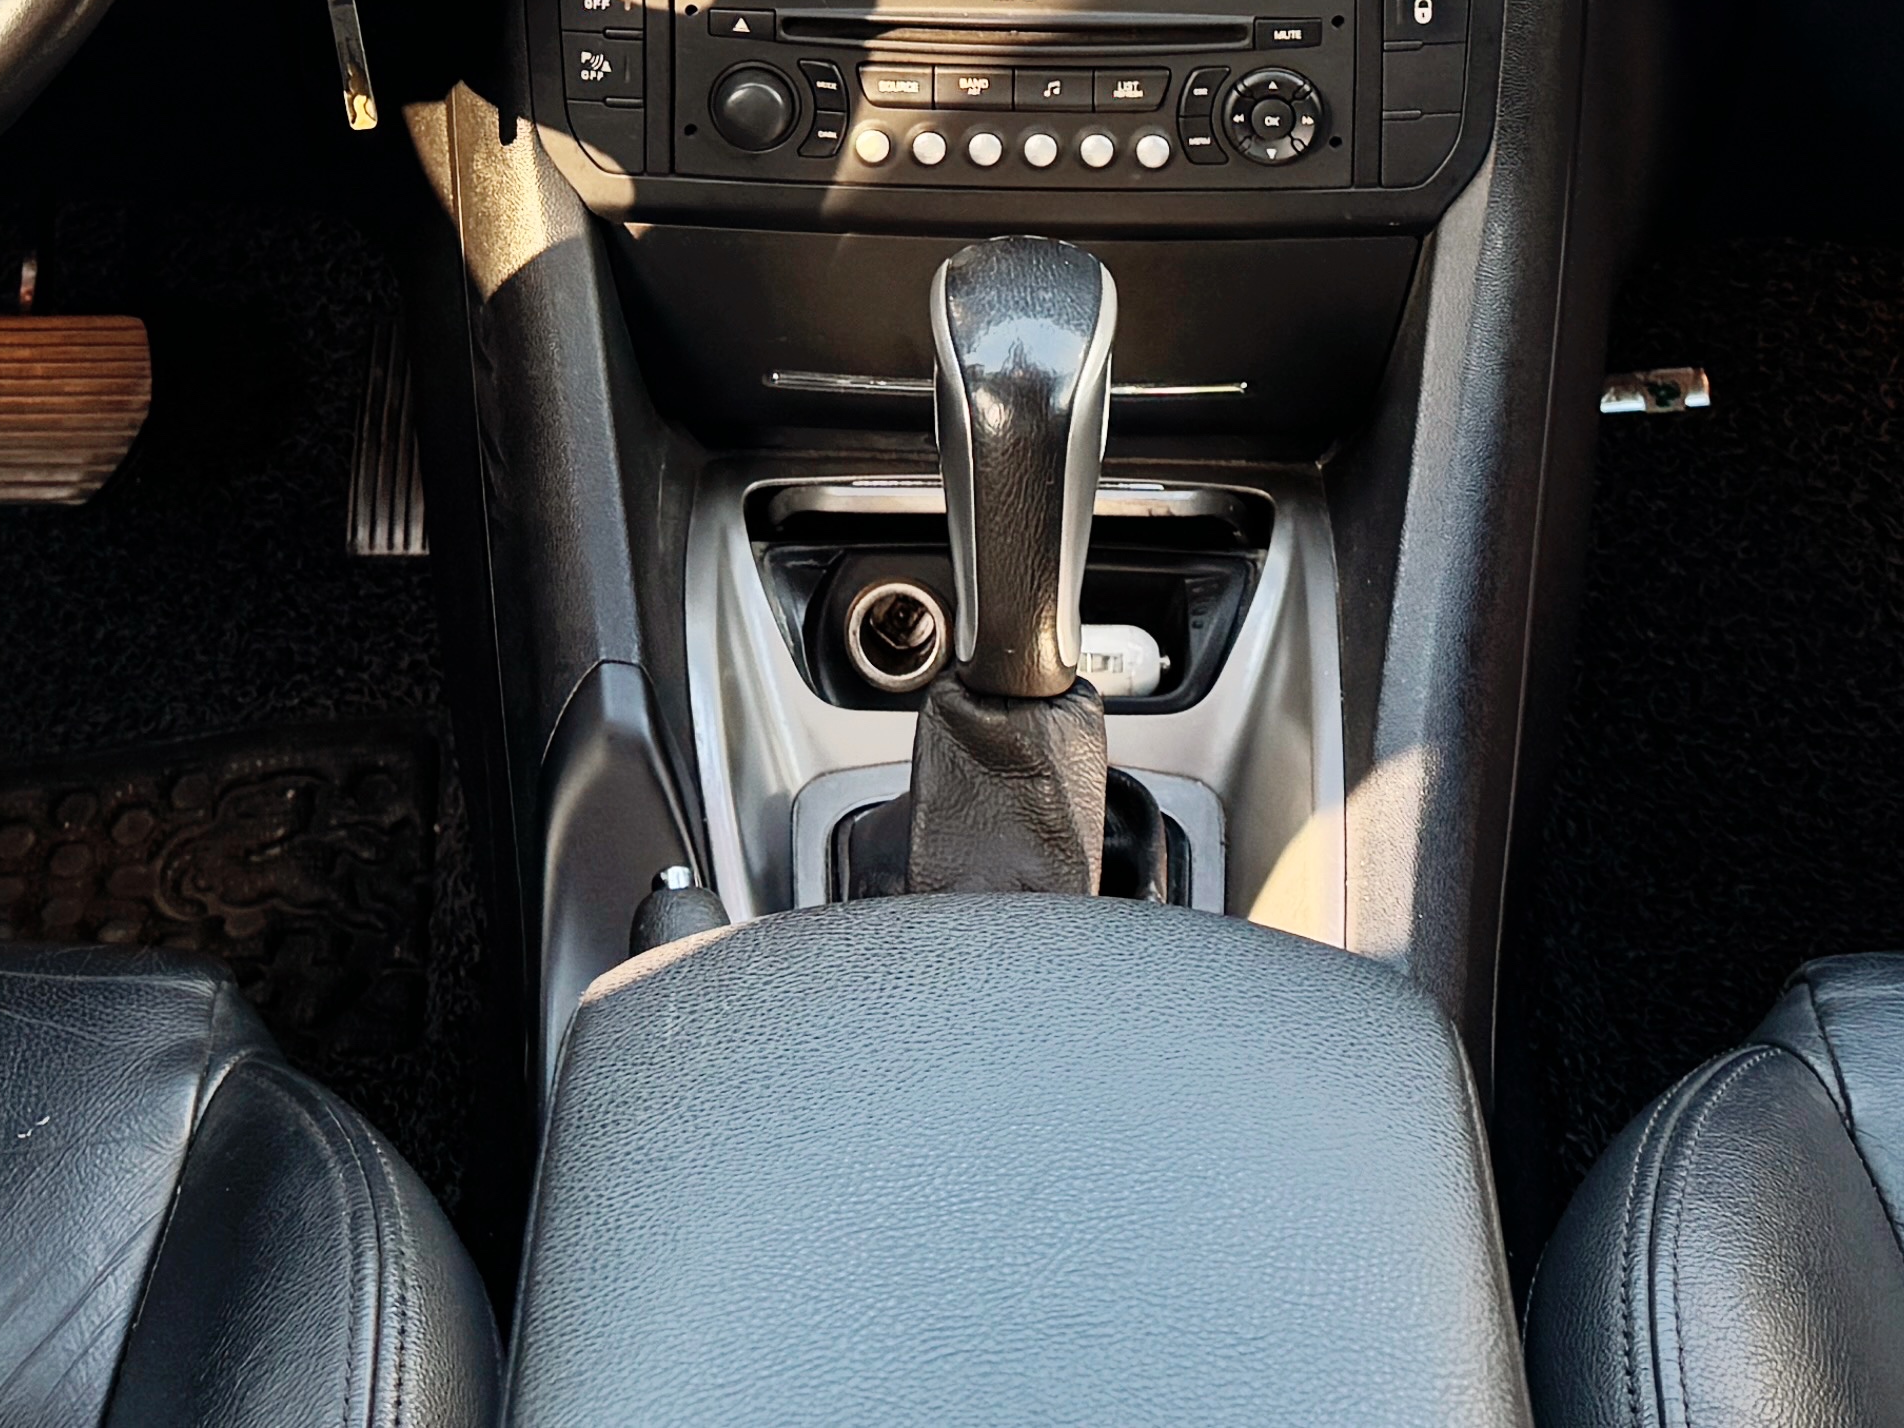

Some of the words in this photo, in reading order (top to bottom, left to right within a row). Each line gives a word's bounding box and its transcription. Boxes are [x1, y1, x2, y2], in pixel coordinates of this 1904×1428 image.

[1273, 30, 1302, 41] MUTE
[580, 70, 604, 81] OFF
[878, 81, 919, 93] SOURCE
[959, 78, 989, 89] BAND
[1116, 80, 1140, 91] LIST
[1264, 115, 1280, 127] OK
